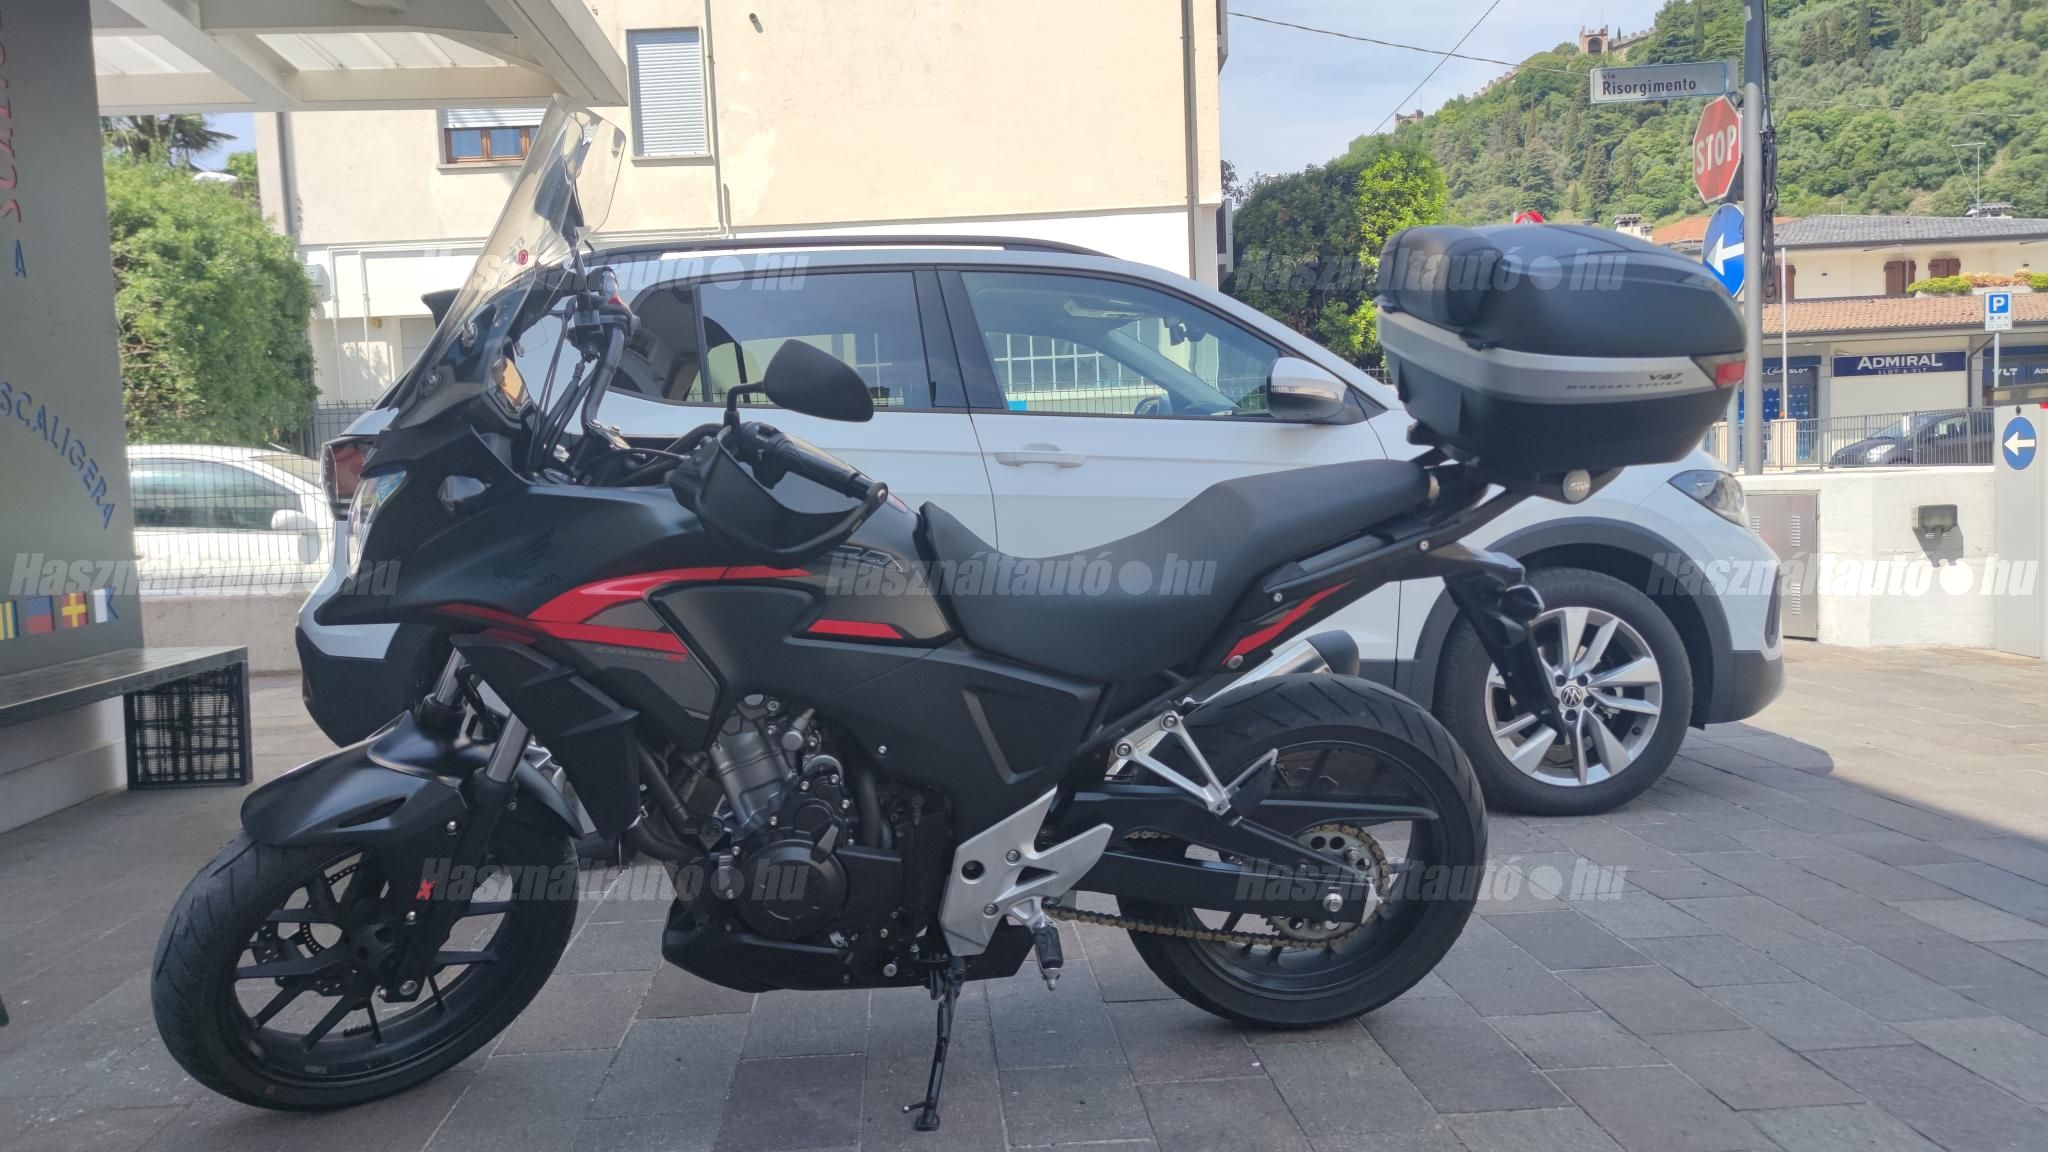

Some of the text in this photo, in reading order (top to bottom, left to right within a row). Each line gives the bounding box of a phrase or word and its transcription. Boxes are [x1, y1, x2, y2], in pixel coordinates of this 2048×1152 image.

[1602, 72, 1616, 80] via
[1602, 77, 1697, 97] Risorgimento
[1696, 125, 1737, 175] STOP
[1857, 353, 1943, 371] ADMIRAL
[0, 381, 116, 529] SCALIGERA
